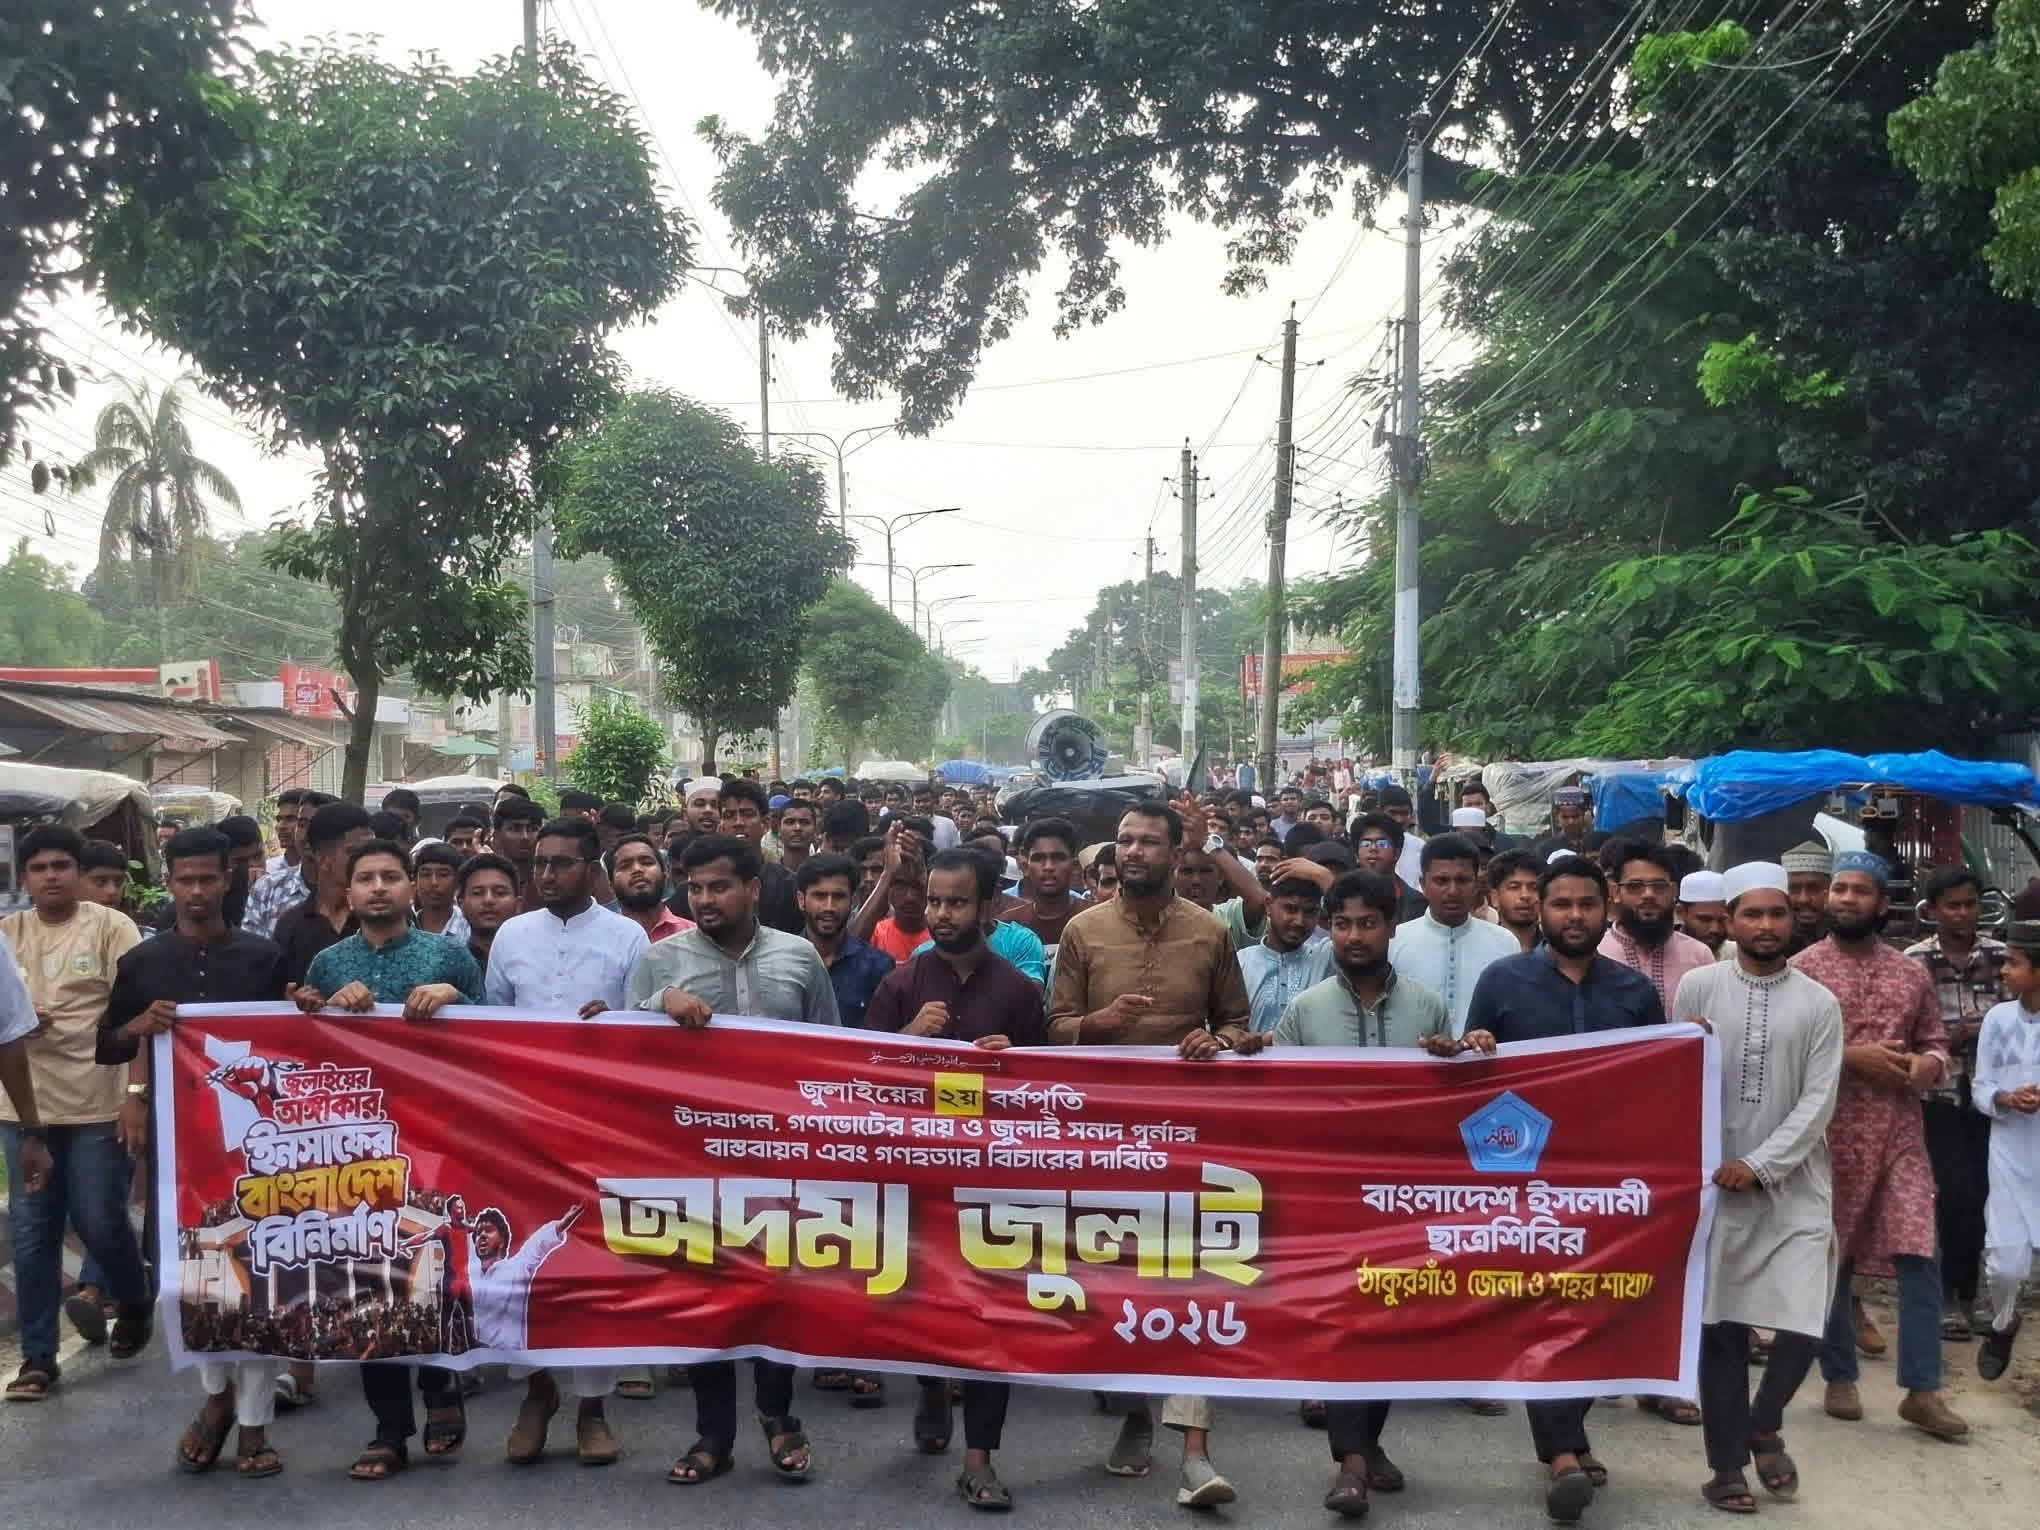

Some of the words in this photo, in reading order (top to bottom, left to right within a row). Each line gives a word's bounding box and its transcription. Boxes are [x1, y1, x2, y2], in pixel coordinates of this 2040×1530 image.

[796, 1078, 928, 1108] জুলাইয়ের
[938, 1088, 980, 1109] ২য়
[244, 1120, 394, 1171] ইনসাফের
[788, 1111, 903, 1136] গণভোটের
[911, 1118, 954, 1137] রায়
[961, 1120, 983, 1137] ও
[990, 1116, 1063, 1146] জুলাই
[1067, 1122, 1123, 1141] সনদ
[704, 1138, 808, 1160] বাস্তবায়ন
[816, 1144, 869, 1162] এবং
[874, 1146, 980, 1167] গণহত্যার
[988, 1142, 1084, 1169] বিচারের
[1091, 1145, 1168, 1170] দাবিতে
[237, 1158, 407, 1218] বাংলাদেশ
[1361, 1184, 1518, 1215] বাংলাদেশ
[1526, 1178, 1651, 1217] ইসলামী
[252, 1205, 397, 1268] বিনির্মাণ
[595, 1178, 911, 1296] অদম্য
[953, 1162, 1264, 1311] জুলাই
[1426, 1216, 1586, 1256] ছাত্রশিবির
[1356, 1257, 1456, 1306] ঠাকুরগাঁও
[1468, 1270, 1524, 1297] জেলা
[1529, 1272, 1544, 1297] ও
[1549, 1272, 1599, 1300] শহর
[1113, 1299, 1247, 1346] ২০২৬
